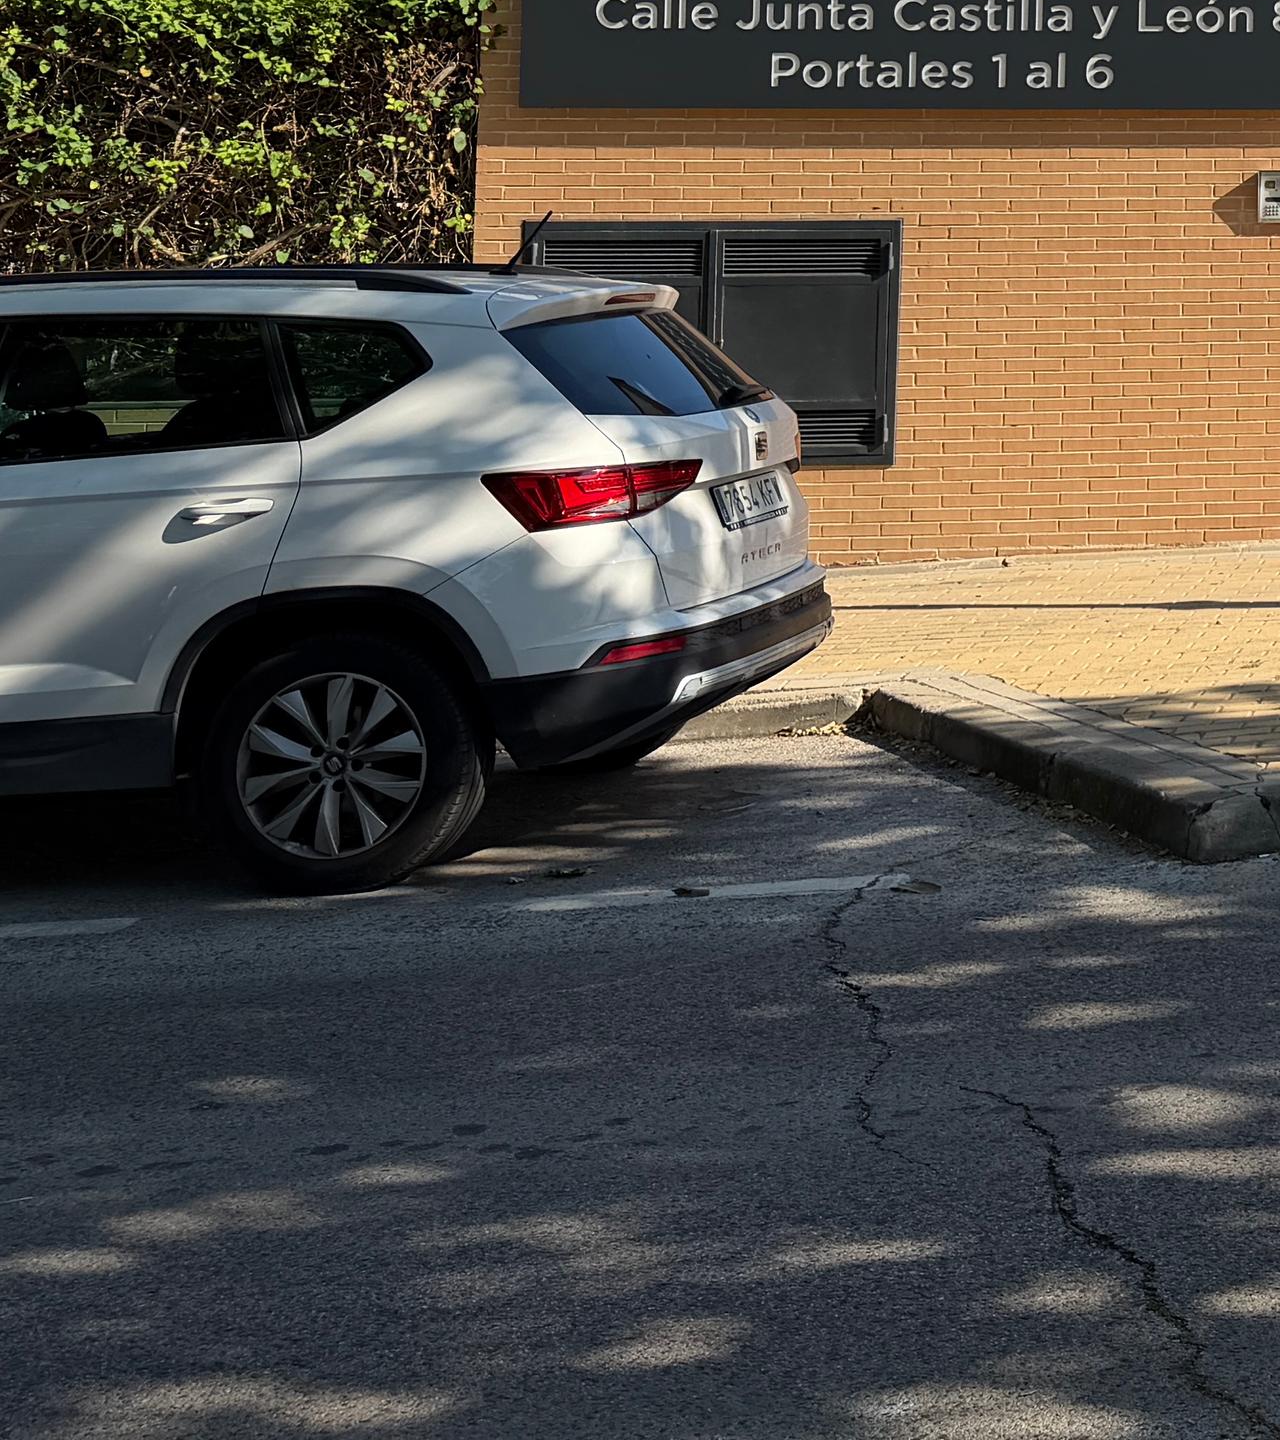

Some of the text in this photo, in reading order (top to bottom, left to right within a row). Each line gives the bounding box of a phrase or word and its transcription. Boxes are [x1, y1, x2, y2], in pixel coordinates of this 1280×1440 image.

[1091, 5, 1119, 40] y
[769, 50, 1115, 90] Portales 1 al 6
[724, 483, 760, 517] 7854
[741, 542, 781, 564] ATECA
